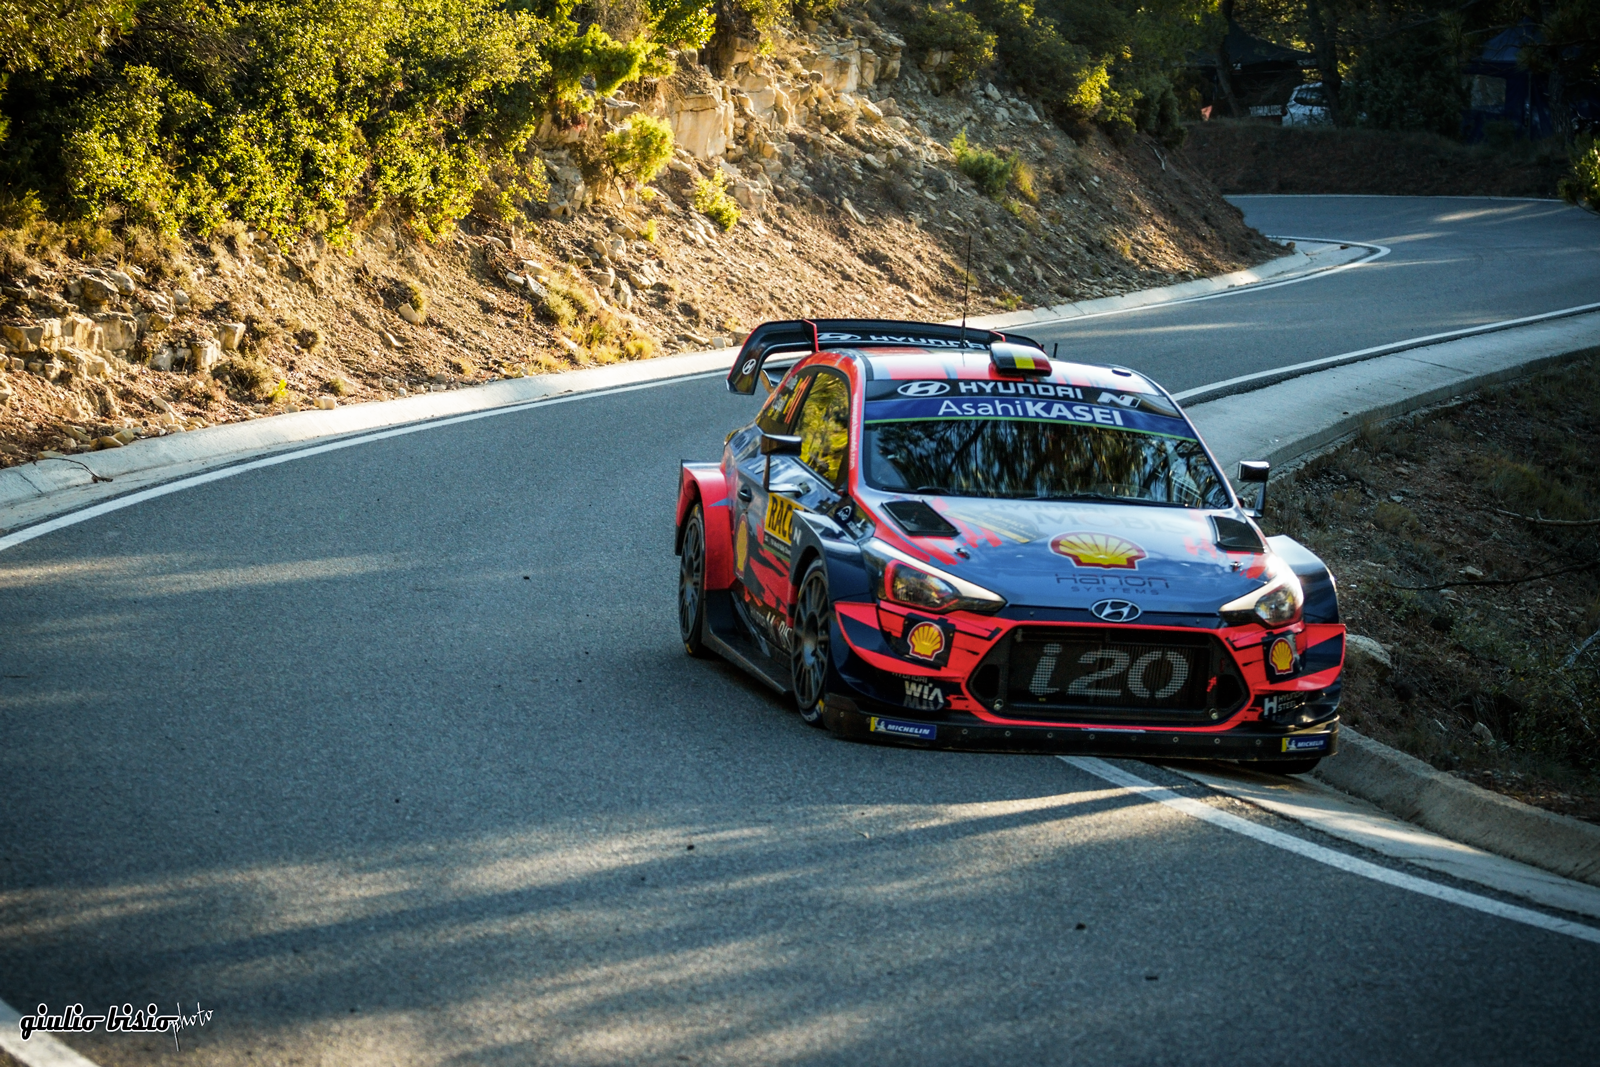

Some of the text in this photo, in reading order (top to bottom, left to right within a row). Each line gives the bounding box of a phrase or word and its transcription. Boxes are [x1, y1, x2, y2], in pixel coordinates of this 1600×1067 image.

[869, 334, 991, 350] HYUNDA
[959, 381, 1083, 400] HYUNDAI
[1033, 511, 1192, 535] MOBIS
[1071, 586, 1159, 595] SYSTEMS
[1029, 643, 1189, 698] i20
[887, 724, 931, 735] MICHELIN
[1297, 740, 1324, 748] MICHELIN
